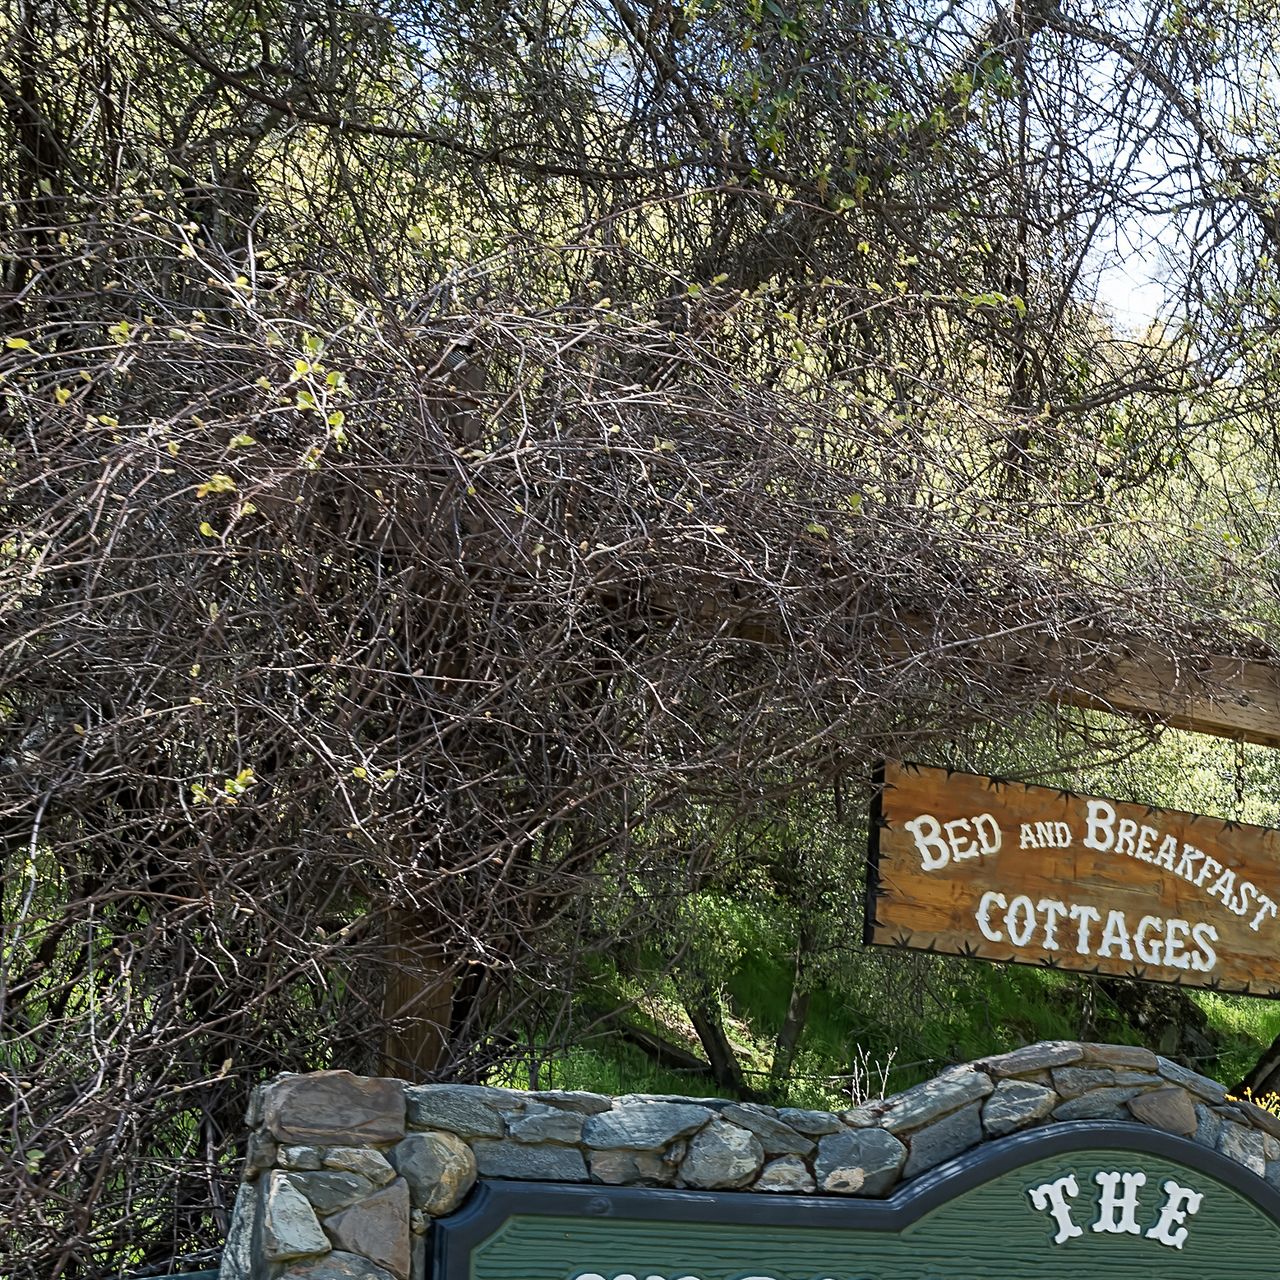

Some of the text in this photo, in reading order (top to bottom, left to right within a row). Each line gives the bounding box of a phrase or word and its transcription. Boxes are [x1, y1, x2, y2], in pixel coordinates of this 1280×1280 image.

[904, 800, 1278, 932] BED AND BREAKFAST
[974, 891, 1219, 972] COTTAGES
[1028, 1171, 1204, 1250] THE
